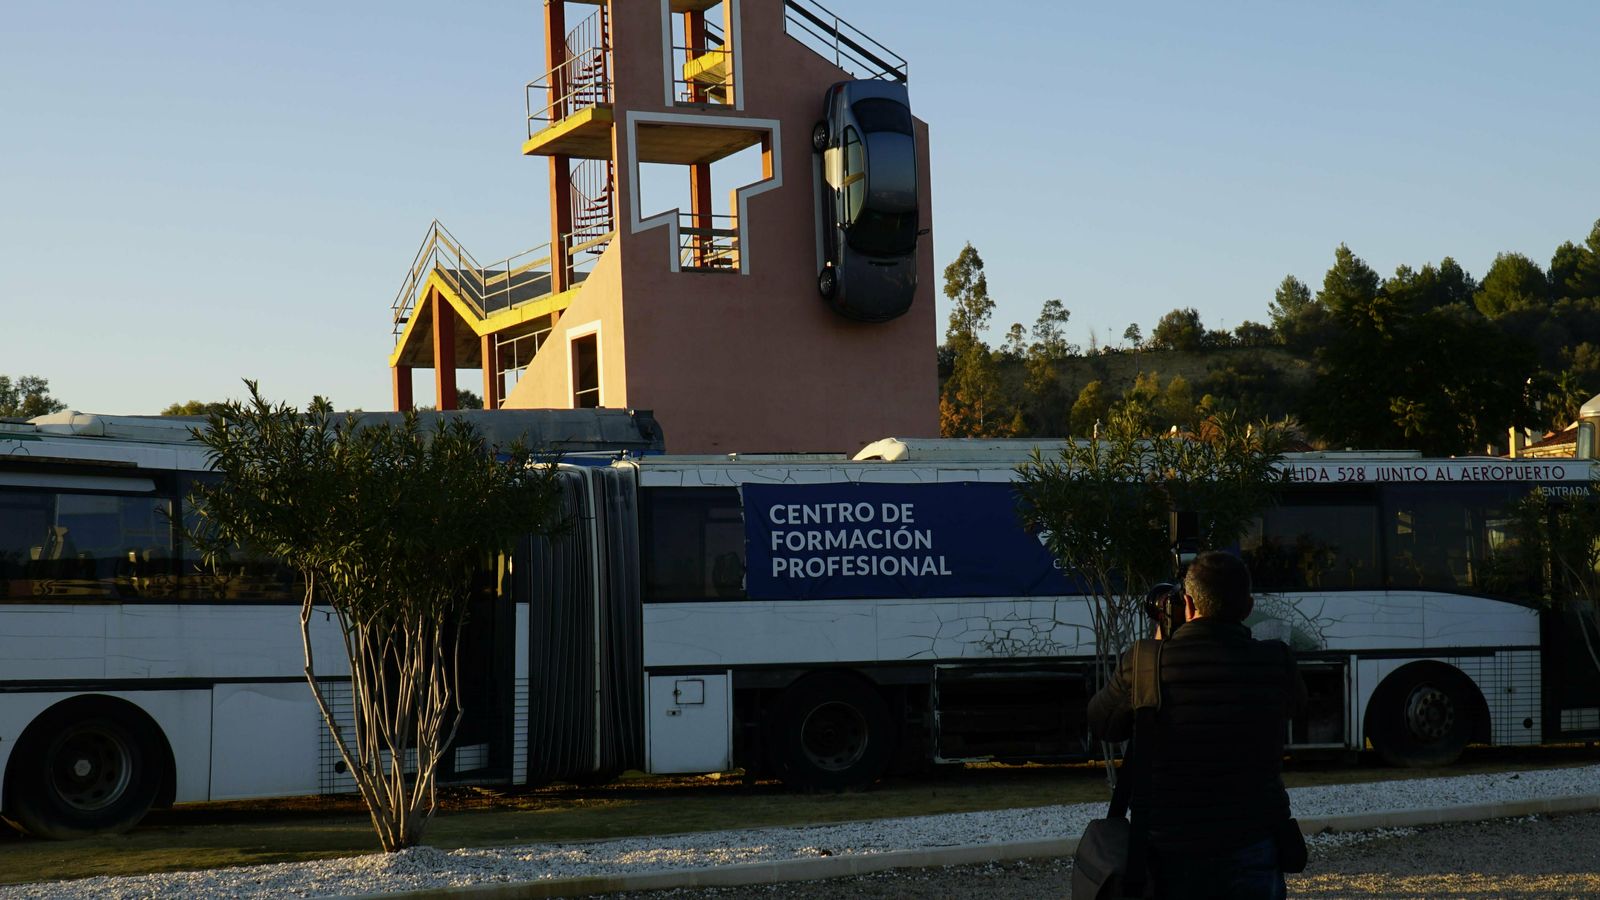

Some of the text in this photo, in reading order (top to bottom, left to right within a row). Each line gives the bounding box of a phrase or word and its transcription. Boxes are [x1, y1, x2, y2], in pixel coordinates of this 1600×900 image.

[1282, 466, 1565, 481] LIDA 528 JUNTO AL AEROPUERTO
[1542, 486, 1590, 496] ENTRADA
[769, 502, 915, 525] CENTRO DE
[771, 525, 932, 551] FORMACIÓN
[772, 555, 952, 578] PROFESIONAL
